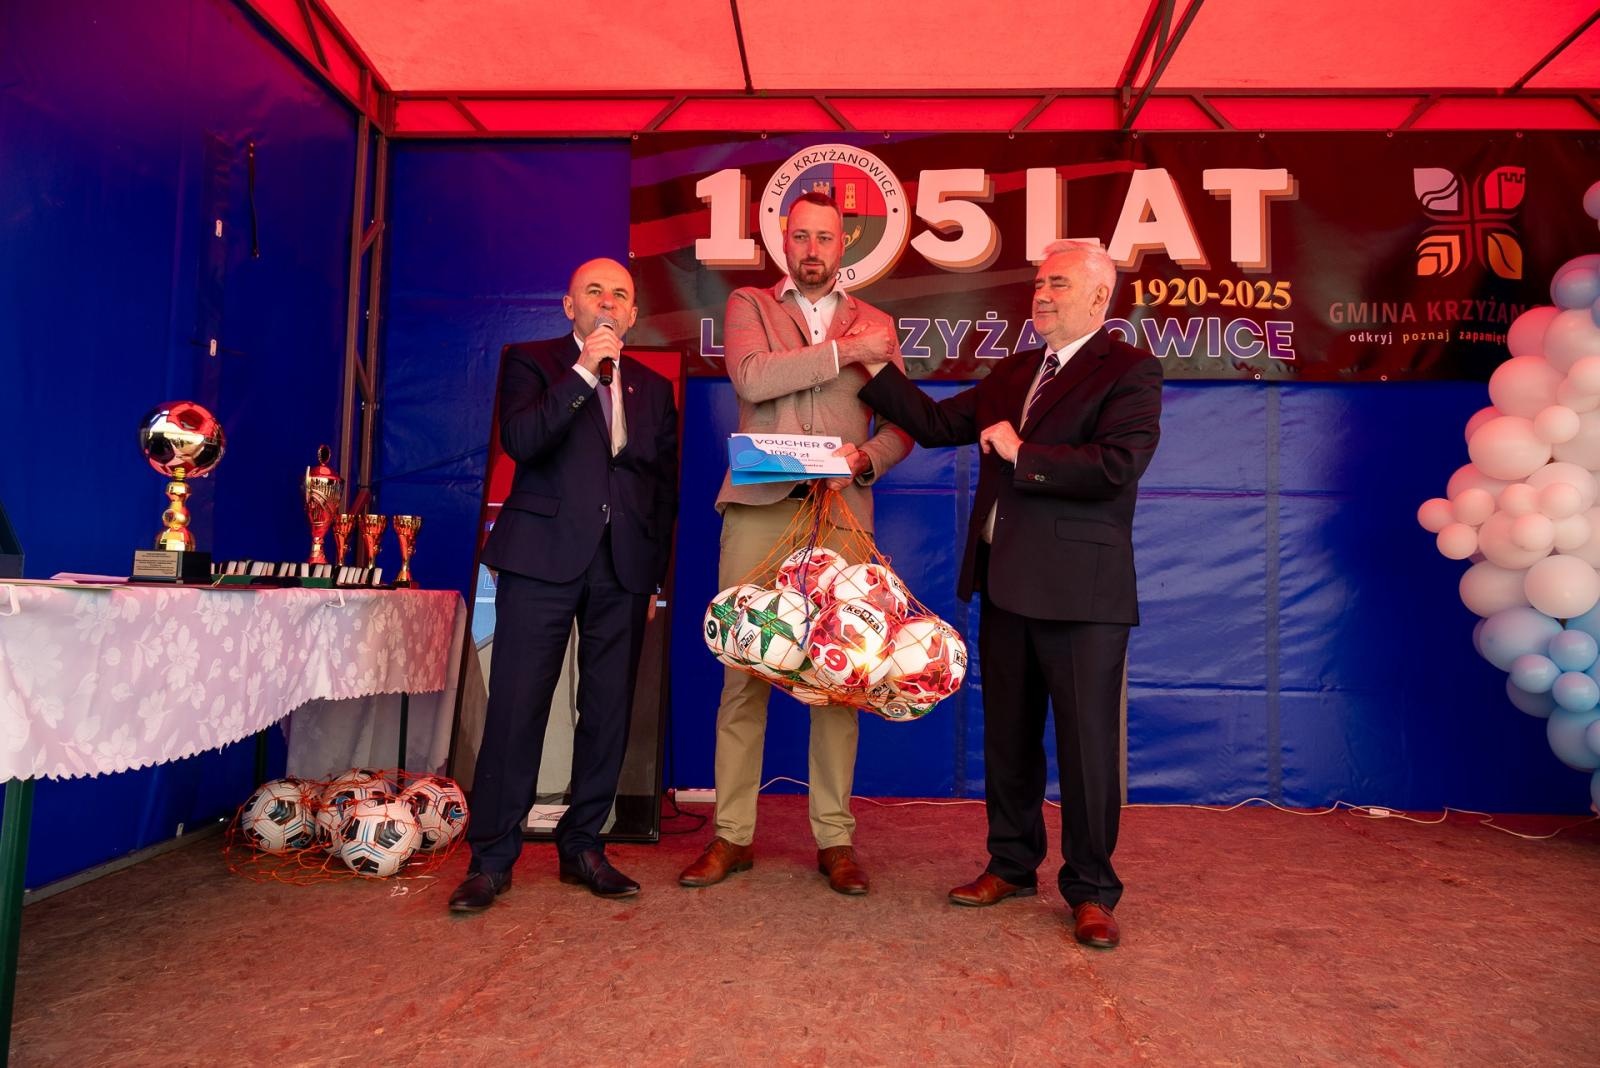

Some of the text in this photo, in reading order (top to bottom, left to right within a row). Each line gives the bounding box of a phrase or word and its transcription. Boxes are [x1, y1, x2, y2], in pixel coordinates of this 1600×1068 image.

[771, 149, 897, 198] LKS KRZYŻANOWICE
[1025, 166, 1293, 264] LAT
[1130, 277, 1293, 310] 1920-2025
[1328, 296, 1541, 325] GMINA KRZYŻAN
[1349, 331, 1393, 345] odkryj
[1402, 329, 1450, 344] poznaj
[755, 439, 821, 449] VOUCHER
